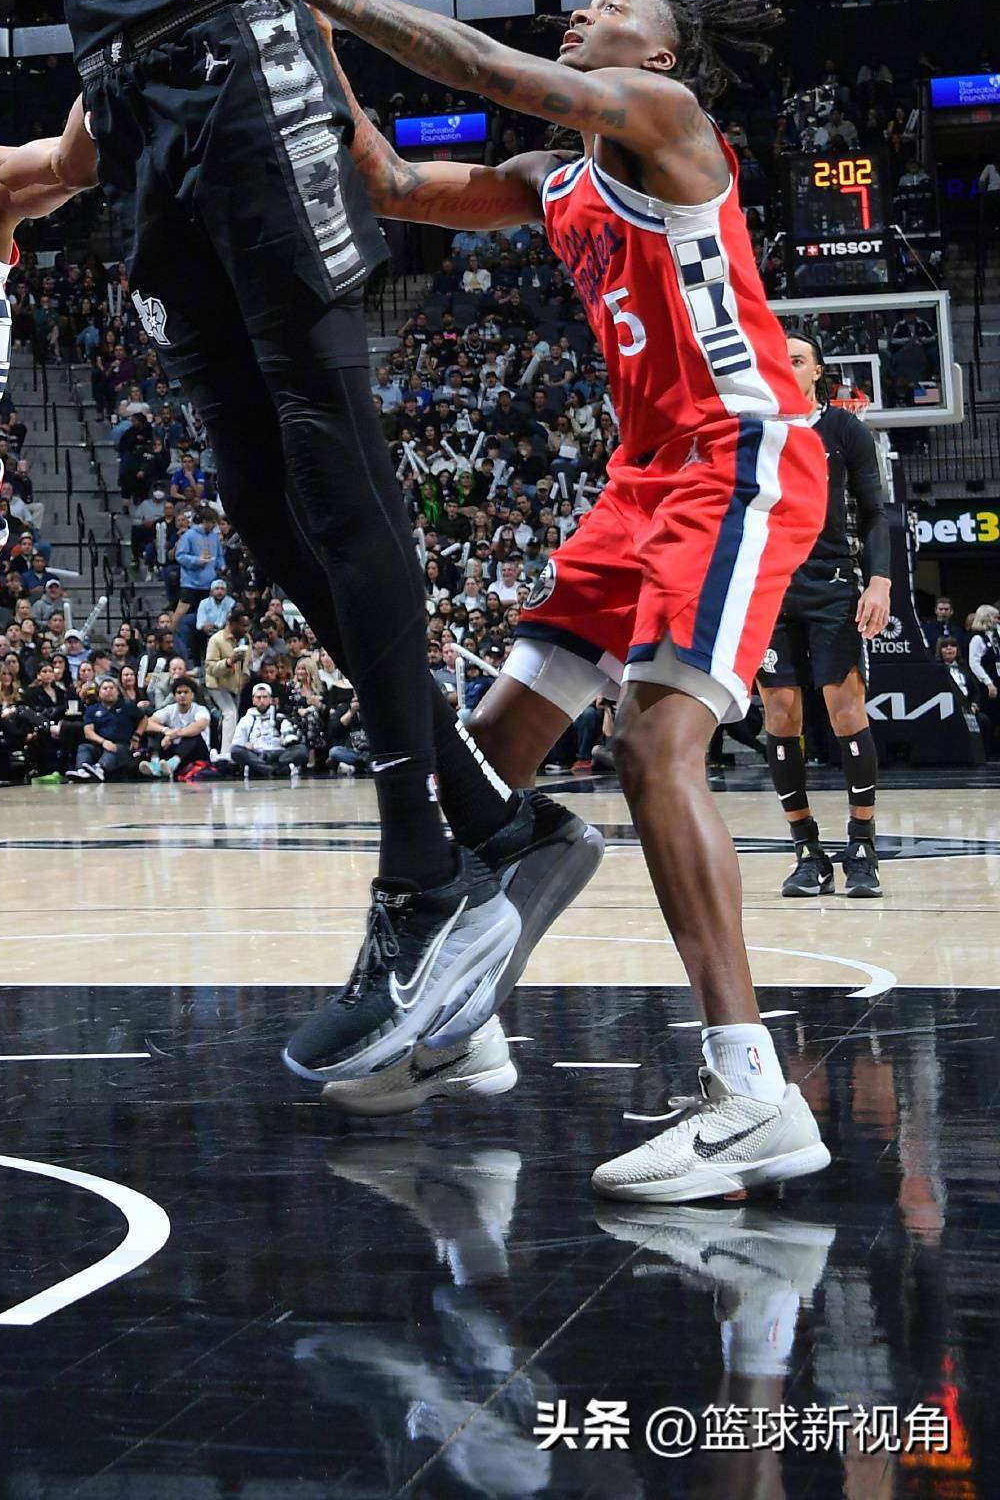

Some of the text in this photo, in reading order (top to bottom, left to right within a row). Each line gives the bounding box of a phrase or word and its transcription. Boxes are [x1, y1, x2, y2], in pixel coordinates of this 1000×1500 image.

[813, 159, 872, 187] 2:02
[840, 186, 871, 231] 7
[819, 240, 883, 256] TISSOT
[602, 287, 647, 357] 5
[871, 638, 911, 655] Frost
